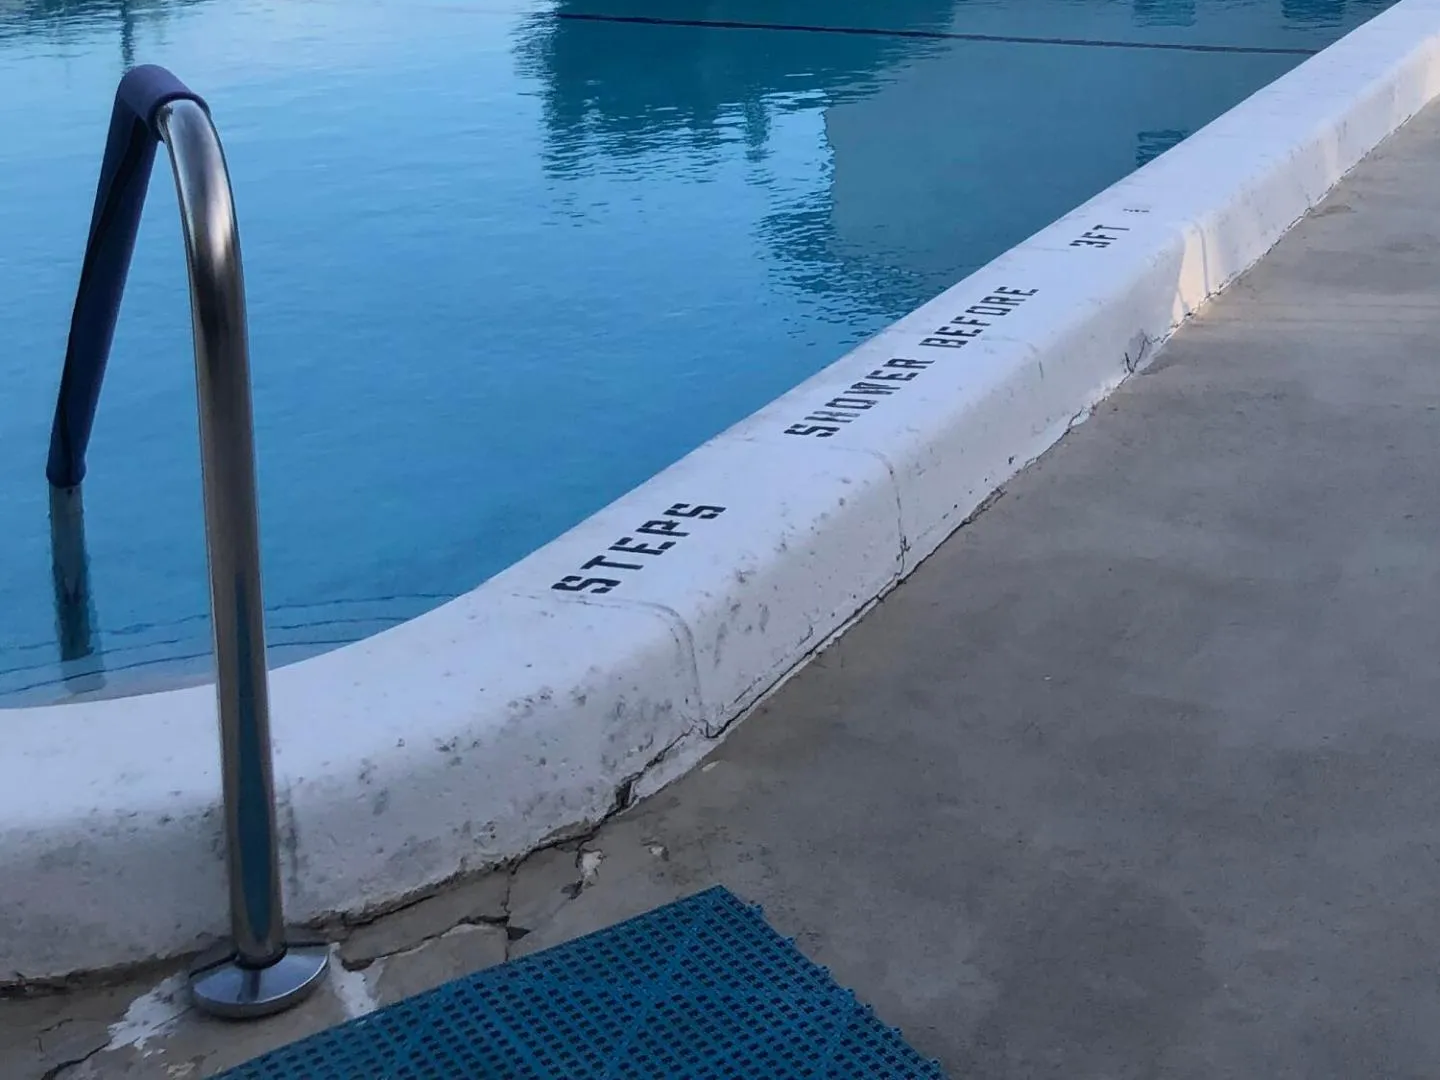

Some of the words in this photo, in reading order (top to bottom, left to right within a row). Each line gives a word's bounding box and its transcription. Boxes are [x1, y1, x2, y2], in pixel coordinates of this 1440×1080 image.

[1069, 224, 1130, 248] 3FT
[784, 358, 935, 437] SHOWER
[918, 286, 1039, 349] BEFORE
[551, 503, 726, 594] STEPS
